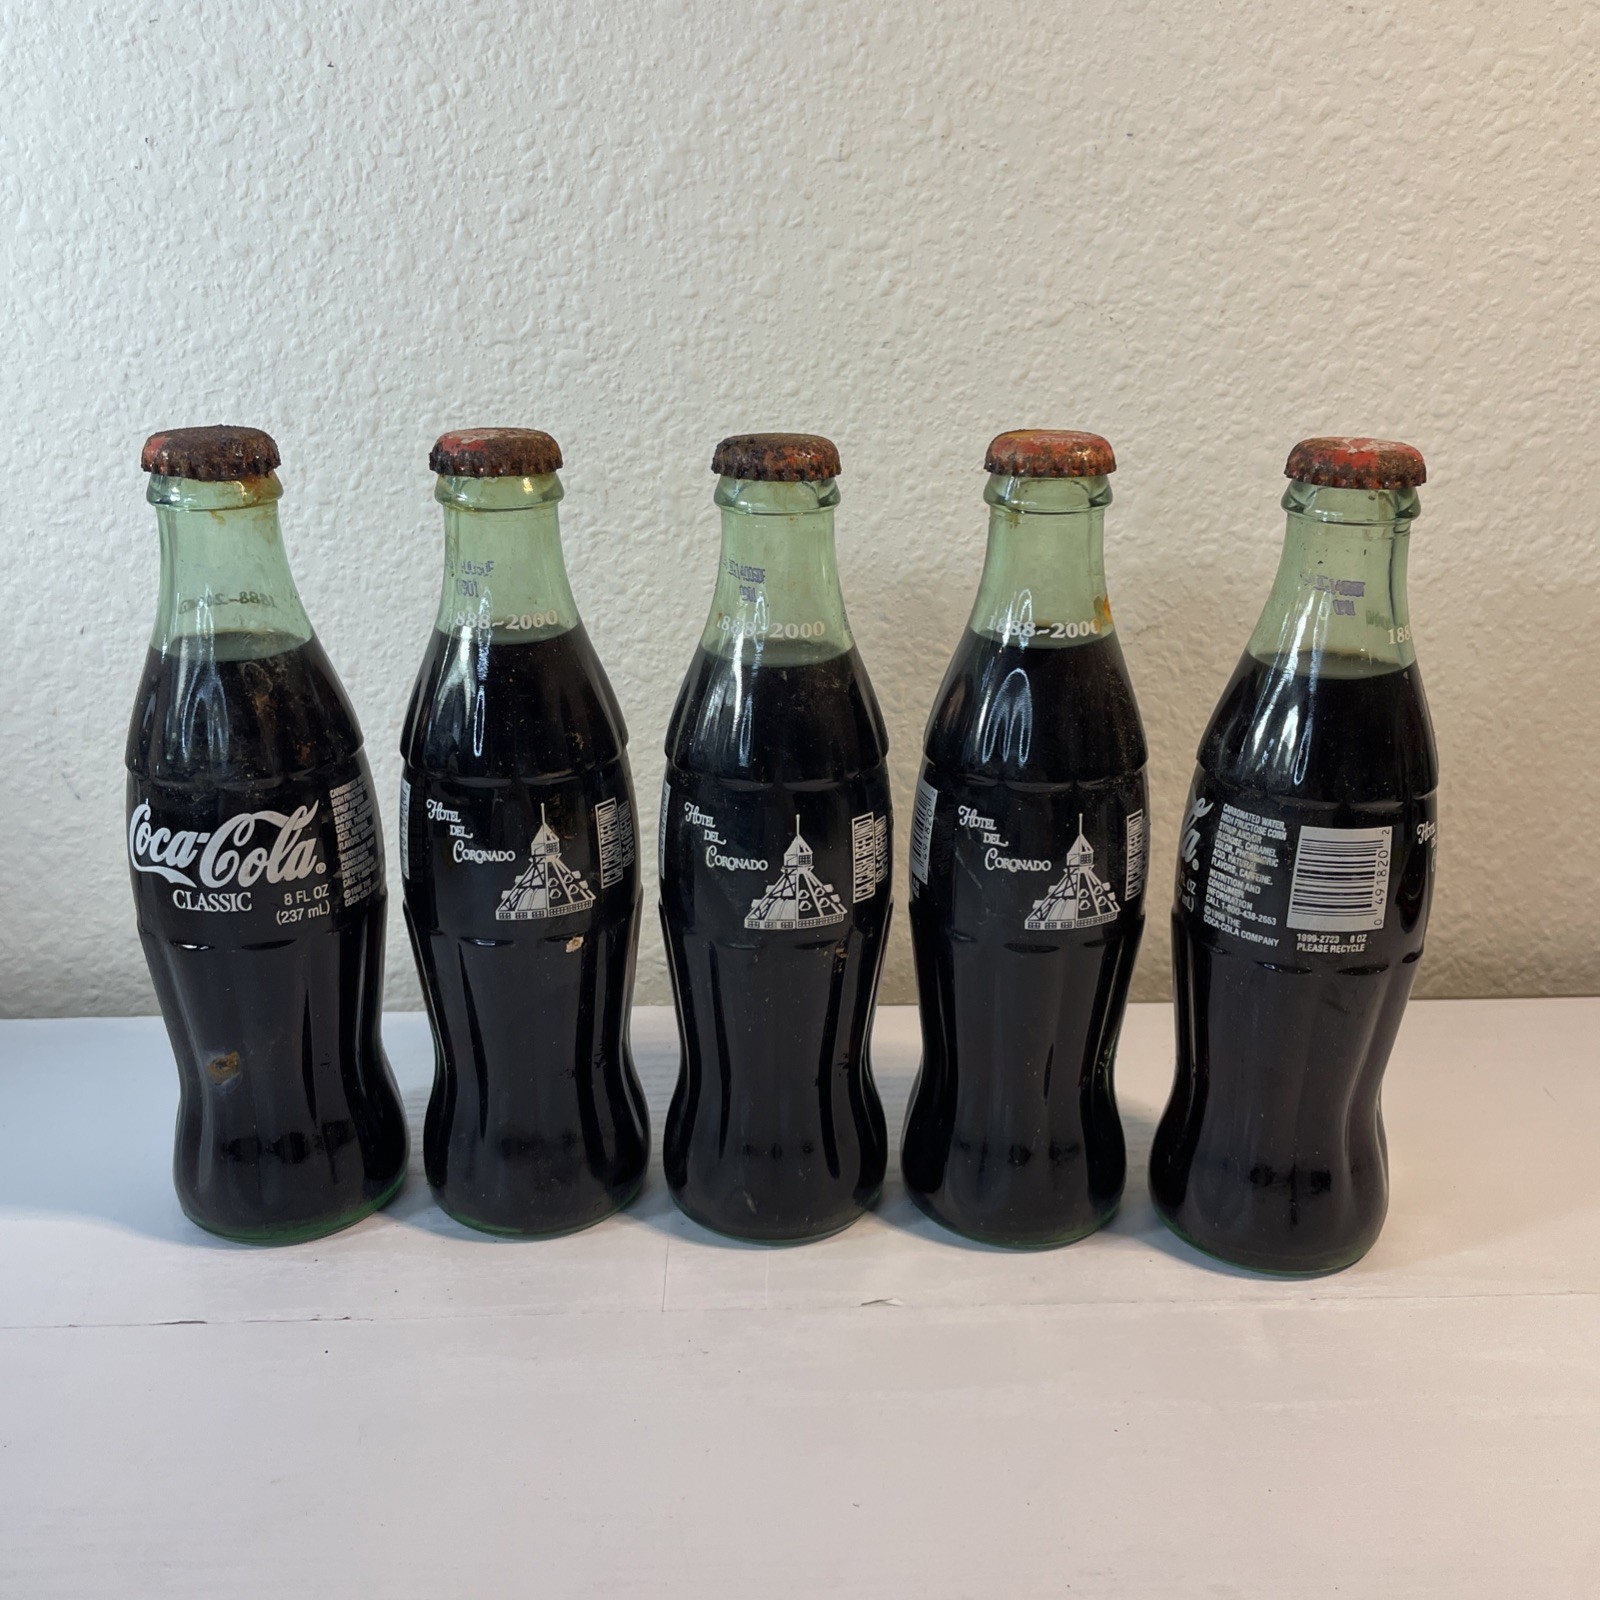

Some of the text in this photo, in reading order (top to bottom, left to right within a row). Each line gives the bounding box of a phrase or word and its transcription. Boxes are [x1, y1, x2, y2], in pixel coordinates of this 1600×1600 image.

[449, 824, 474, 839] DEL
[599, 804, 620, 846] REFUND
[129, 798, 319, 888] Coca-Cola
[703, 830, 727, 845] DEL
[983, 832, 1009, 847] DEL
[453, 840, 516, 864] CORONADO
[601, 840, 621, 870] CASH
[706, 845, 769, 871] CORONADO
[854, 819, 875, 898] CA CASH REFUND
[984, 848, 1052, 873] CORONADO
[173, 889, 253, 912] CLASSIC
[284, 893, 292, 906] 8
[295, 889, 311, 904] FL
[313, 883, 330, 901] OZ
[1206, 894, 1220, 908] CALL
[276, 901, 331, 926] (237 mL)
[1226, 914, 1241, 928] THE
[1240, 930, 1279, 947] COMPANY
[1296, 943, 1366, 954] PLEASE RECYCLE
